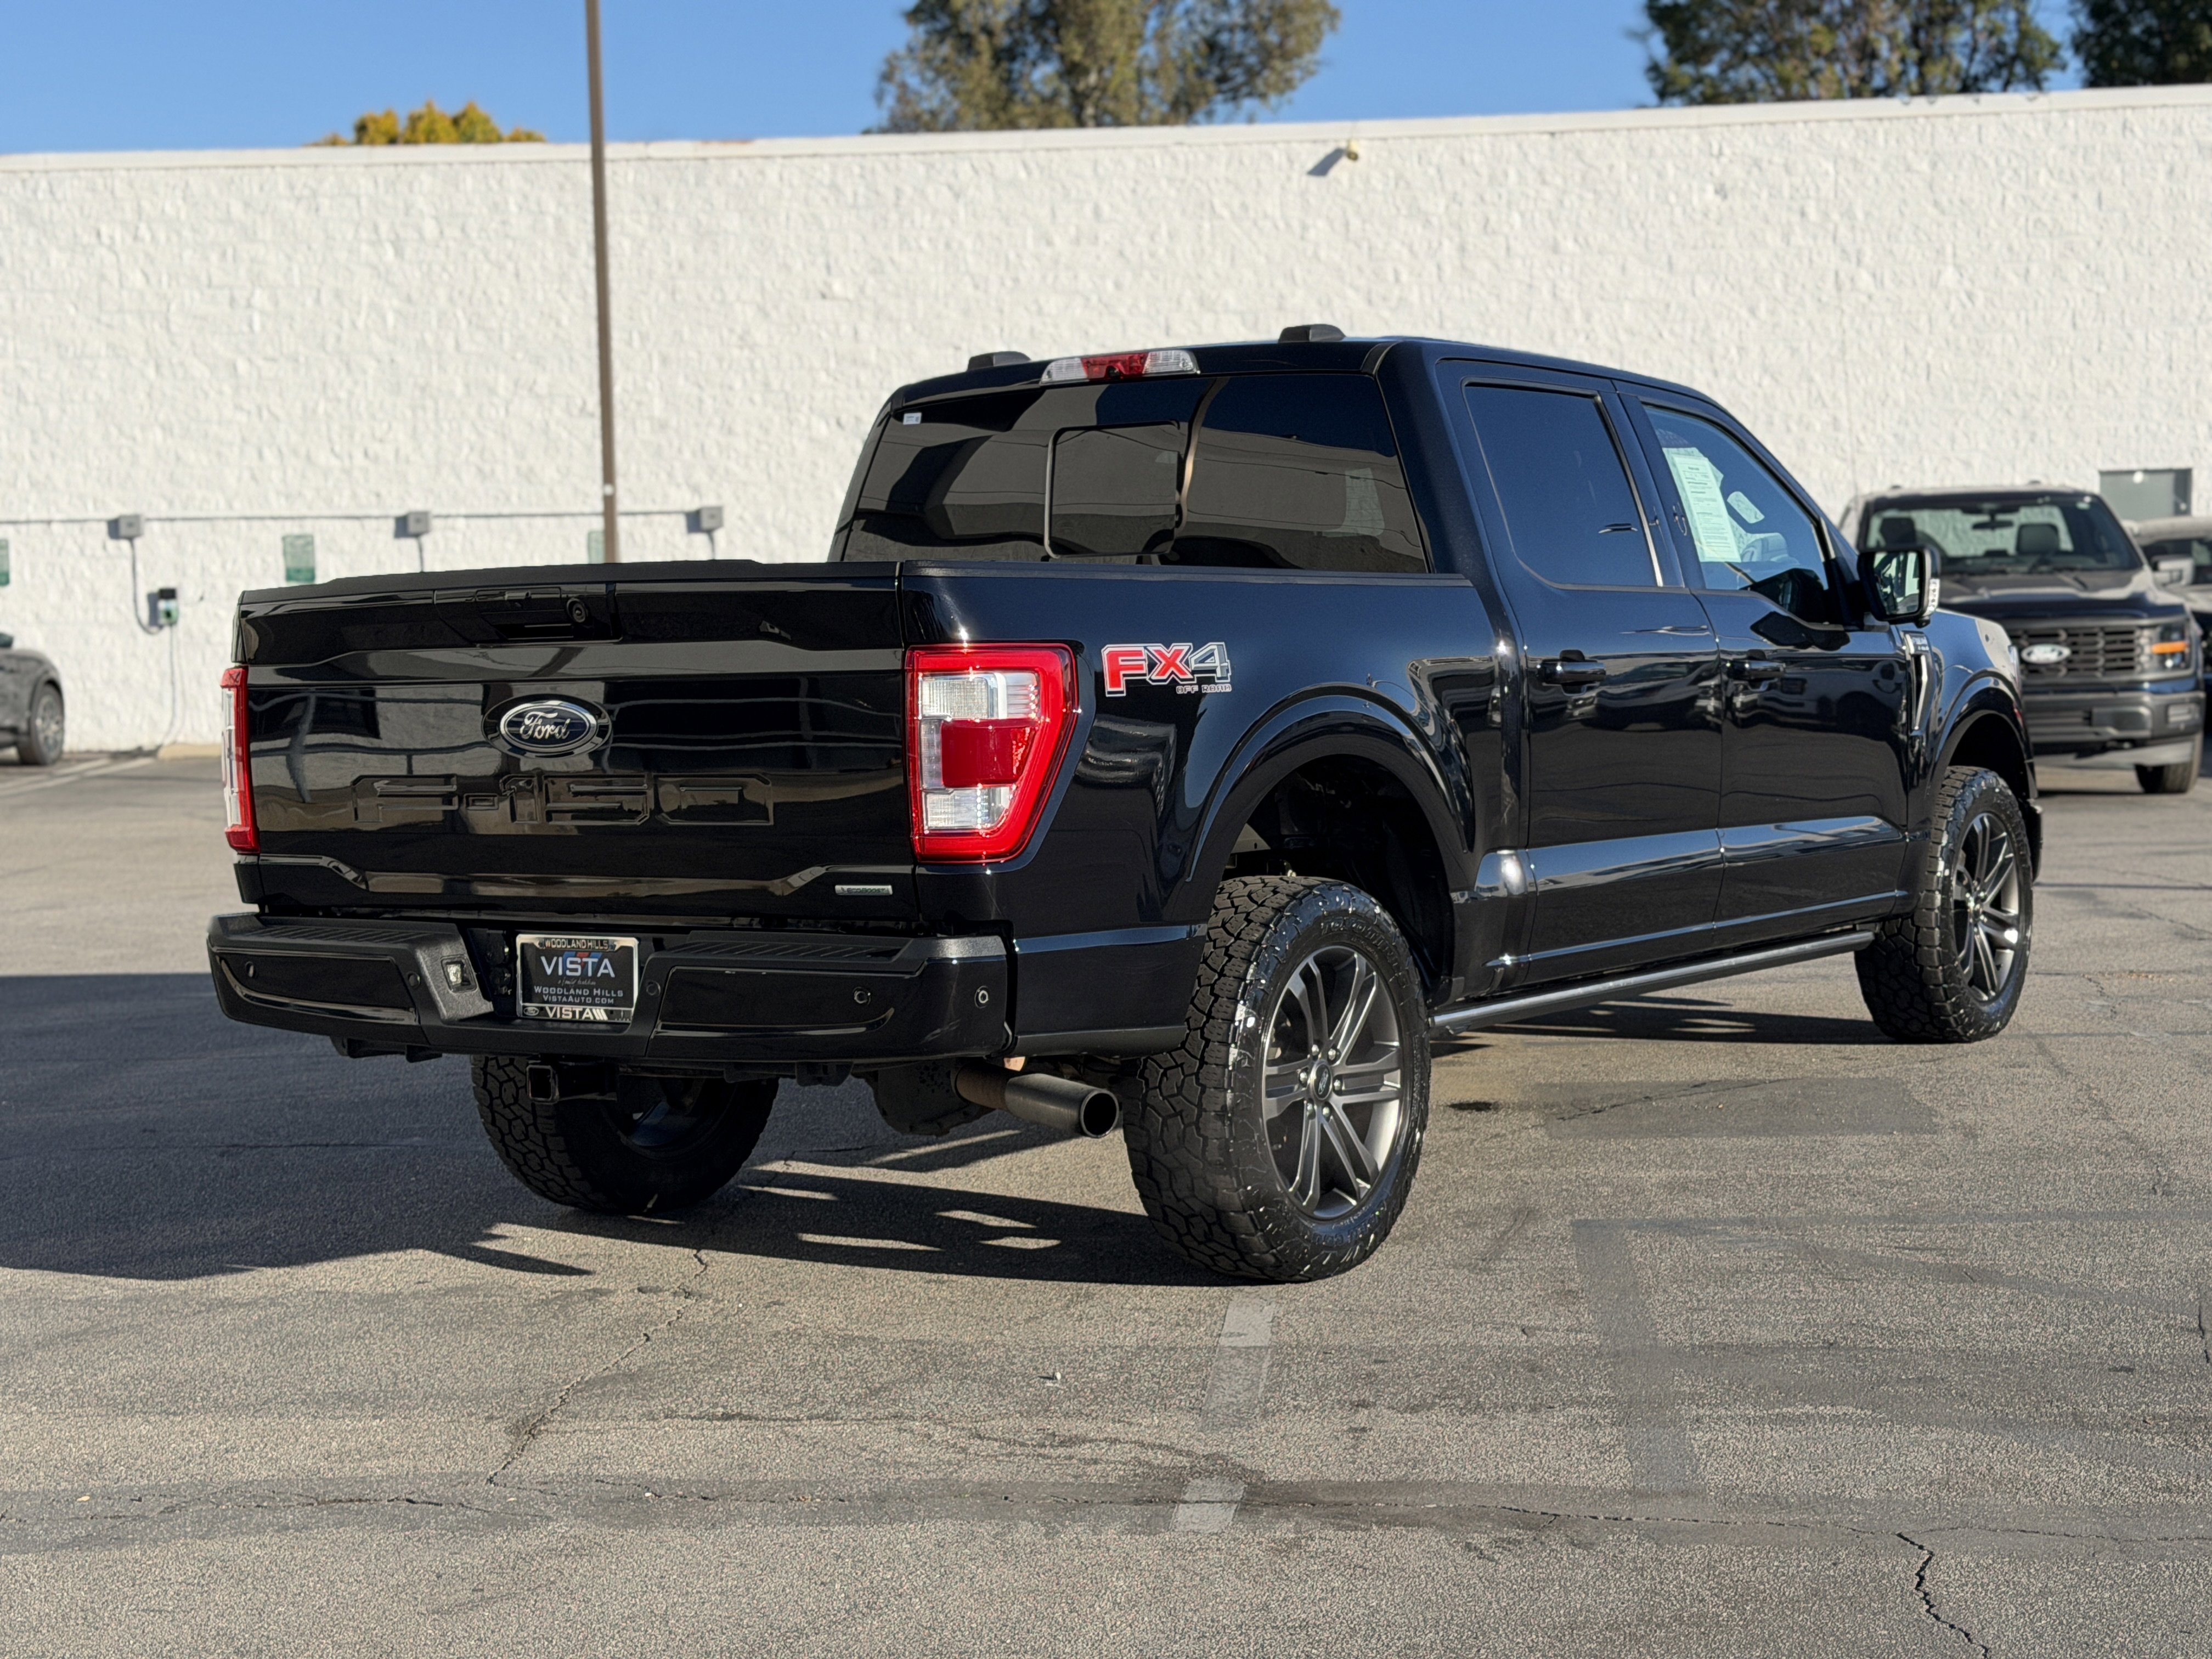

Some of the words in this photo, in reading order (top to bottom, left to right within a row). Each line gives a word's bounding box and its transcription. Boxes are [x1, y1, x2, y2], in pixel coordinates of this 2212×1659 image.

[1101, 642, 1232, 697] FX4
[1176, 685, 1199, 694] OFF
[1201, 684, 1232, 693] ROAD
[520, 711, 571, 740] Ford
[545, 938, 587, 950] WOODLAND
[588, 939, 608, 950] HILLS
[540, 956, 616, 978] VISTA
[534, 985, 590, 996] WOODLAND
[593, 988, 624, 997] HILLS
[545, 1006, 594, 1020] VISTA
